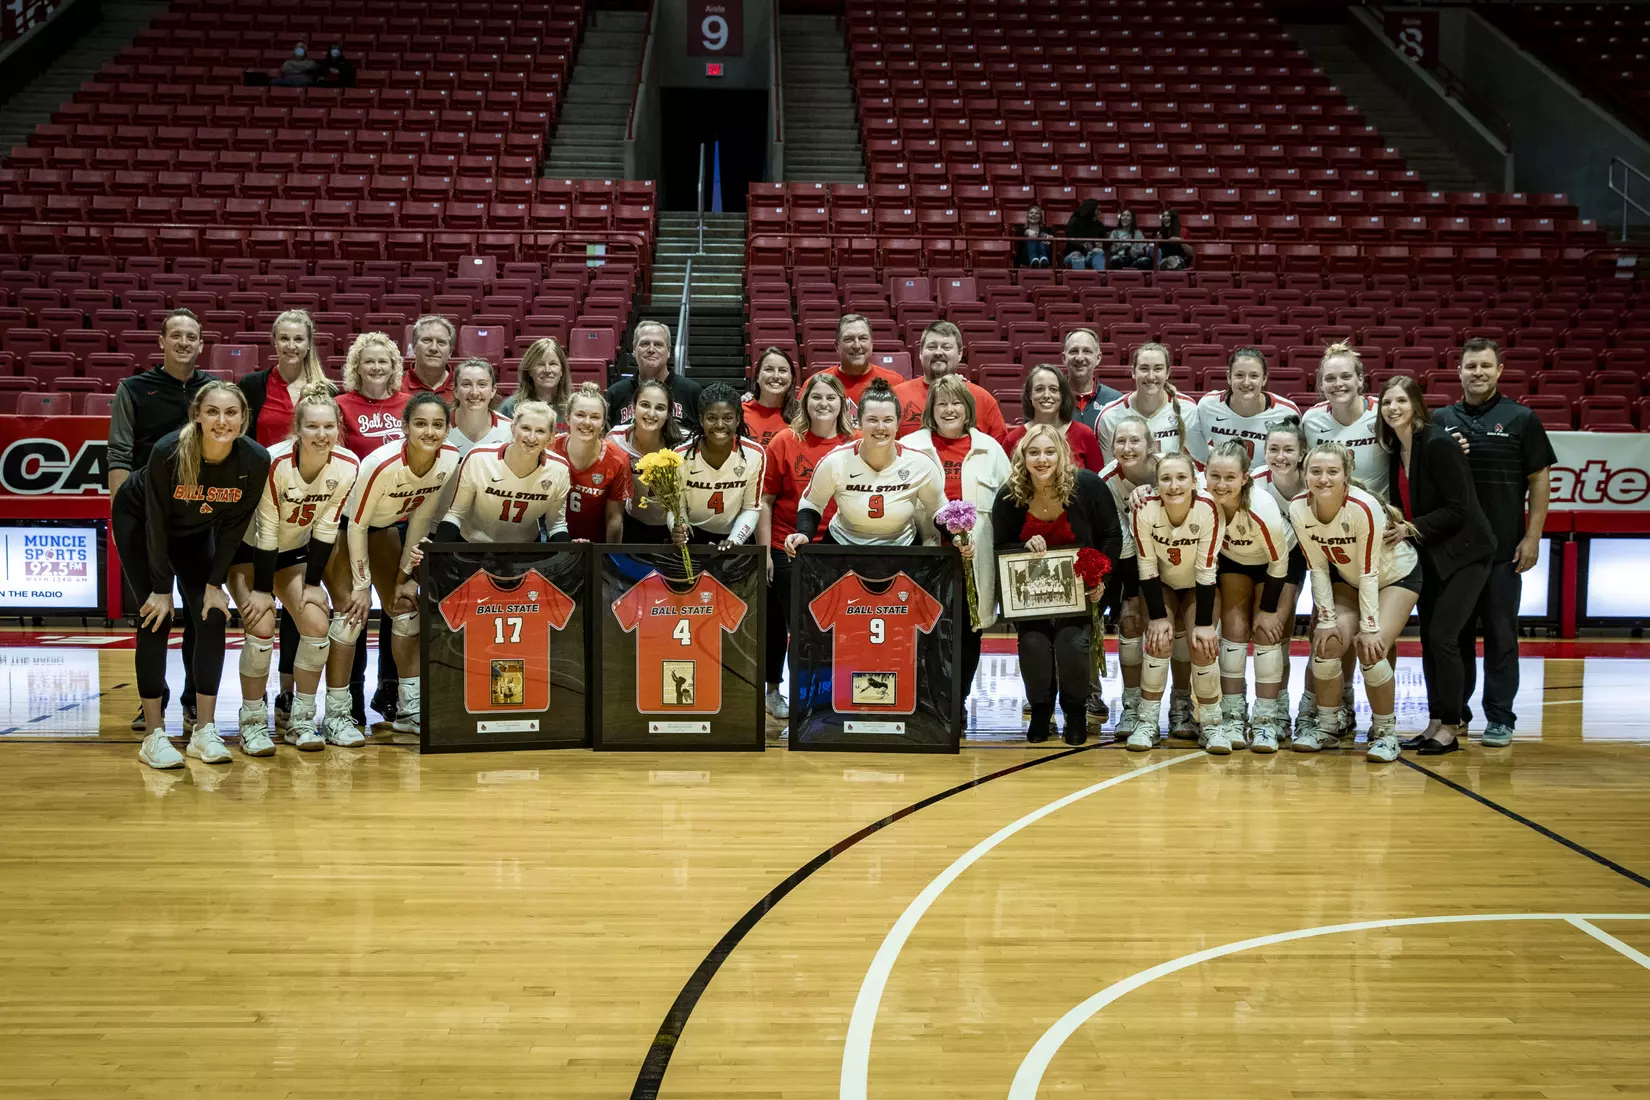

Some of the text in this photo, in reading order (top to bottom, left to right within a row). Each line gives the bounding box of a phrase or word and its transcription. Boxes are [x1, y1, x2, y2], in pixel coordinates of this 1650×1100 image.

[705, 5, 726, 13] Aisle
[701, 14, 729, 51] 9
[357, 412, 384, 433] Ball
[1211, 426, 1239, 437] BALL
[173, 484, 243, 503] BALL STATE
[485, 486, 549, 501] BALL STATE
[574, 484, 606, 497] STATE
[687, 480, 748, 490] BALL STATE
[846, 484, 911, 493] BALL STATE
[499, 499, 529, 524] 17
[707, 491, 724, 515] 4
[868, 494, 885, 519] 9
[286, 503, 317, 527] 15
[24, 535, 87, 548] MUNCIE
[1167, 547, 1182, 566] 3
[1321, 545, 1352, 565] 16
[476, 604, 539, 616] BALL STATE
[650, 605, 713, 617] BALL STATE
[846, 605, 909, 616] BALL STATE
[494, 616, 523, 644] 17
[672, 618, 692, 647] 4
[869, 617, 886, 645] 9
